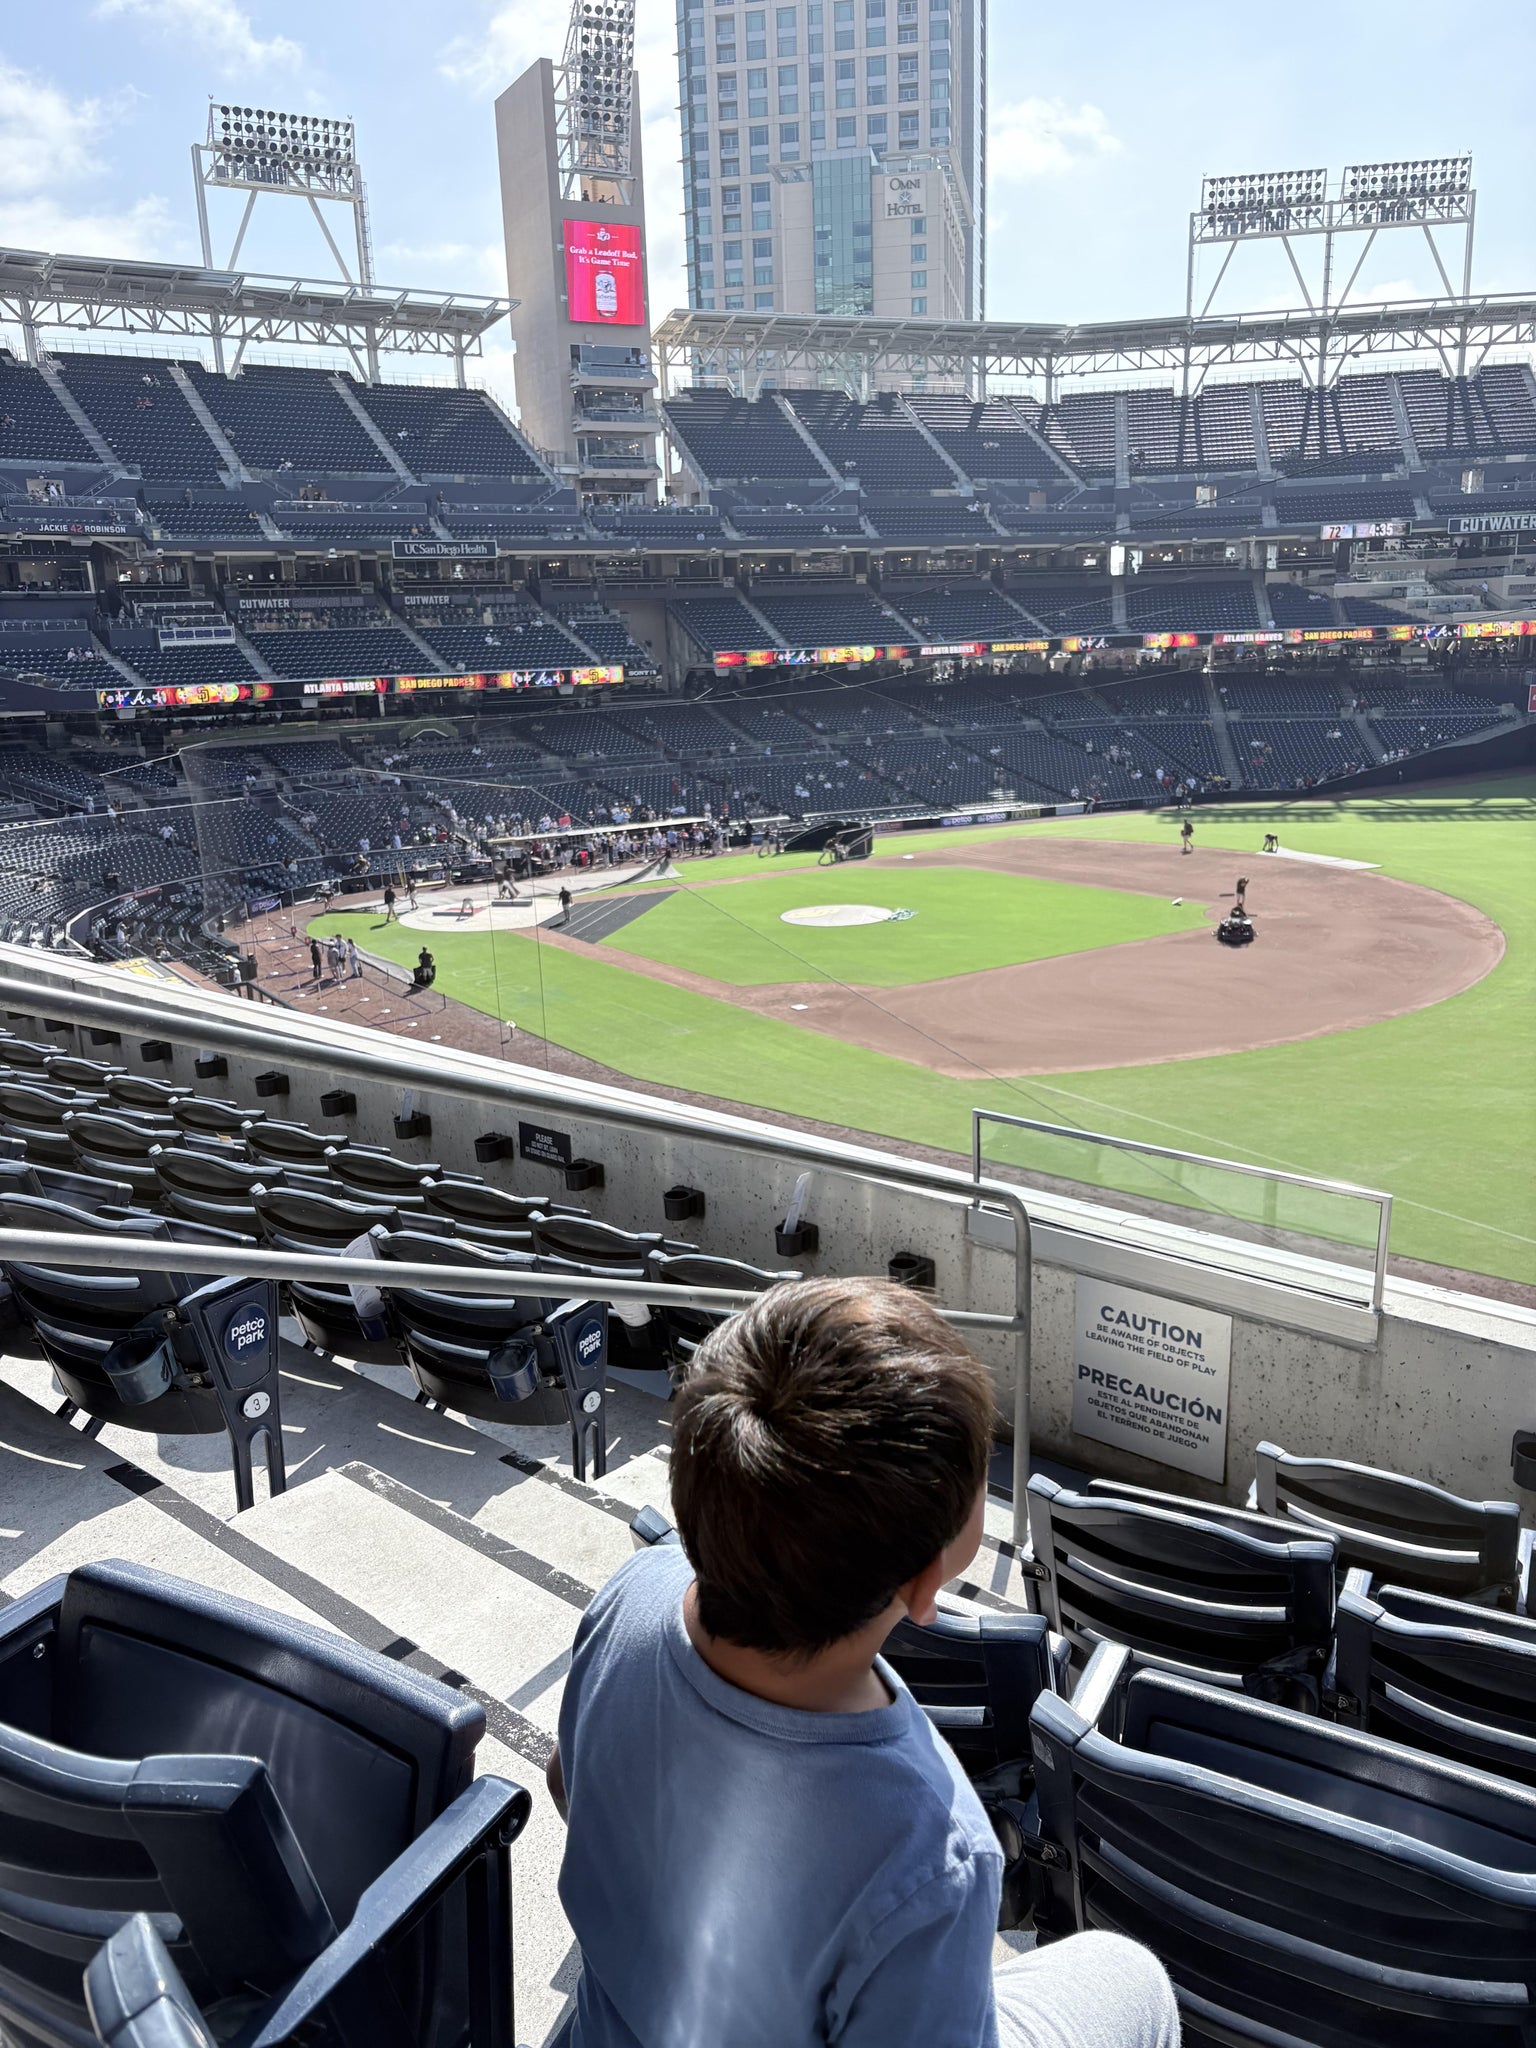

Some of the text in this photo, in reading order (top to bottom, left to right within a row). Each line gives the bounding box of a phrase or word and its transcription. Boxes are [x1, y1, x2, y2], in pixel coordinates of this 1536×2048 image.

[887, 203, 923, 216] HOTEL
[569, 246, 588, 255] Grab
[594, 248, 620, 257] Leadoff
[591, 257, 611, 266] Game
[612, 258, 630, 267] Time
[39, 524, 126, 533] JACKIE 42 ROBINSON
[1369, 523, 1394, 537] 4:35
[1460, 516, 1536, 532] CUTWATER
[404, 543, 487, 556] UC San Diego Health
[239, 598, 290, 609] CUTWATER
[405, 595, 450, 605] CUTWATER
[1223, 633, 1283, 643] ATLANTA BRAVES
[1304, 630, 1373, 640] SAN DIEGO PADRES
[304, 680, 376, 694] ATLANTA BRAVES
[399, 677, 475, 690] SAN DIEGO PADRES
[535, 1132, 553, 1145] PLEASE
[231, 1317, 265, 1341] petco
[1100, 1305, 1203, 1349] CAUTION
[238, 1328, 265, 1350] park
[579, 1330, 601, 1351] petco
[1096, 1323, 1205, 1362] BE AWARE OF OBJECTS
[583, 1338, 601, 1359] park
[1085, 1331, 1217, 1377] LEAVING THE FIELD OF PLAY
[1078, 1363, 1222, 1425] PRECAUCIÓN
[253, 1398, 261, 1411] 3
[589, 1396, 595, 1407] 2
[1097, 1390, 1200, 1430] ESTE AL PENDIENTE DE
[1087, 1397, 1210, 1443] OBJETOS QUE ABANDONAN
[1097, 1410, 1198, 1450] EL TERRENO DE JUEGO
